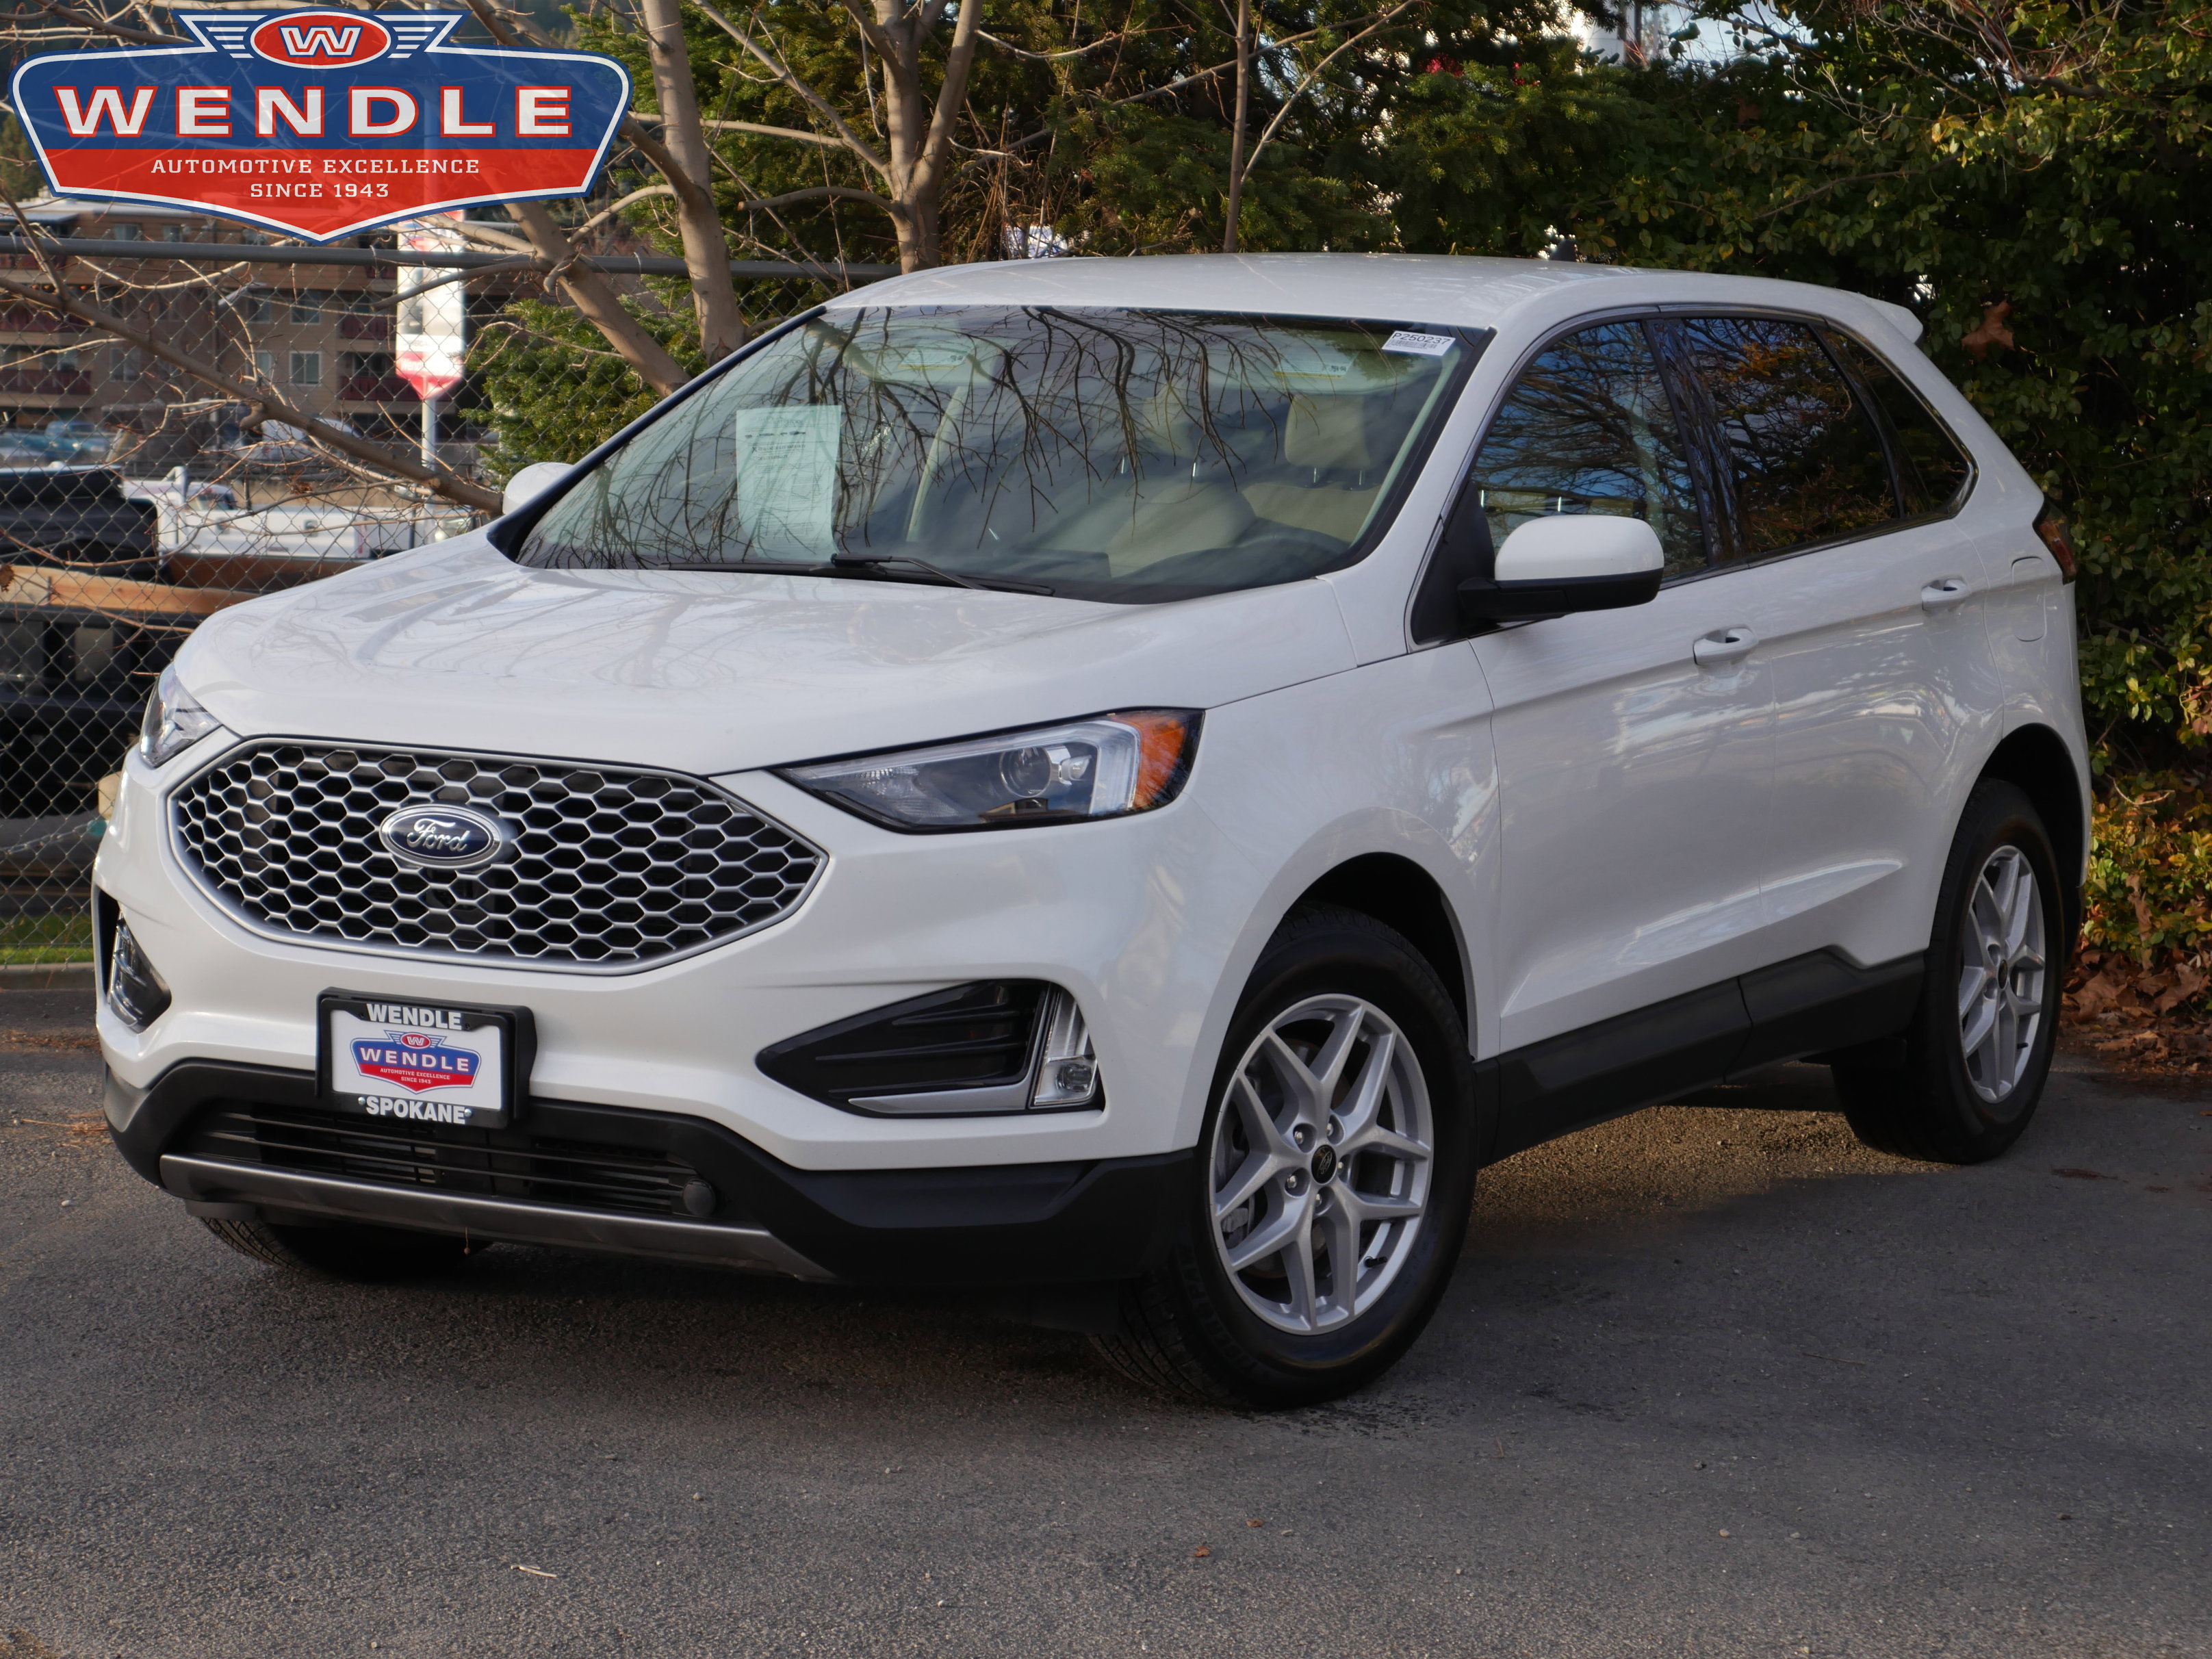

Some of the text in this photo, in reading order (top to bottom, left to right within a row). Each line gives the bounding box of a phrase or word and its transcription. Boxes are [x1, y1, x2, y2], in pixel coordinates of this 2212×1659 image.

[1392, 333, 1451, 345] P250237
[407, 818, 470, 852] Ford
[366, 1003, 462, 1031] WENDLE
[359, 1047, 469, 1072] WENDLE
[380, 1068, 450, 1080] AUTOMOTIVE EXCELLENCE
[366, 1096, 466, 1124] SPOKANE
